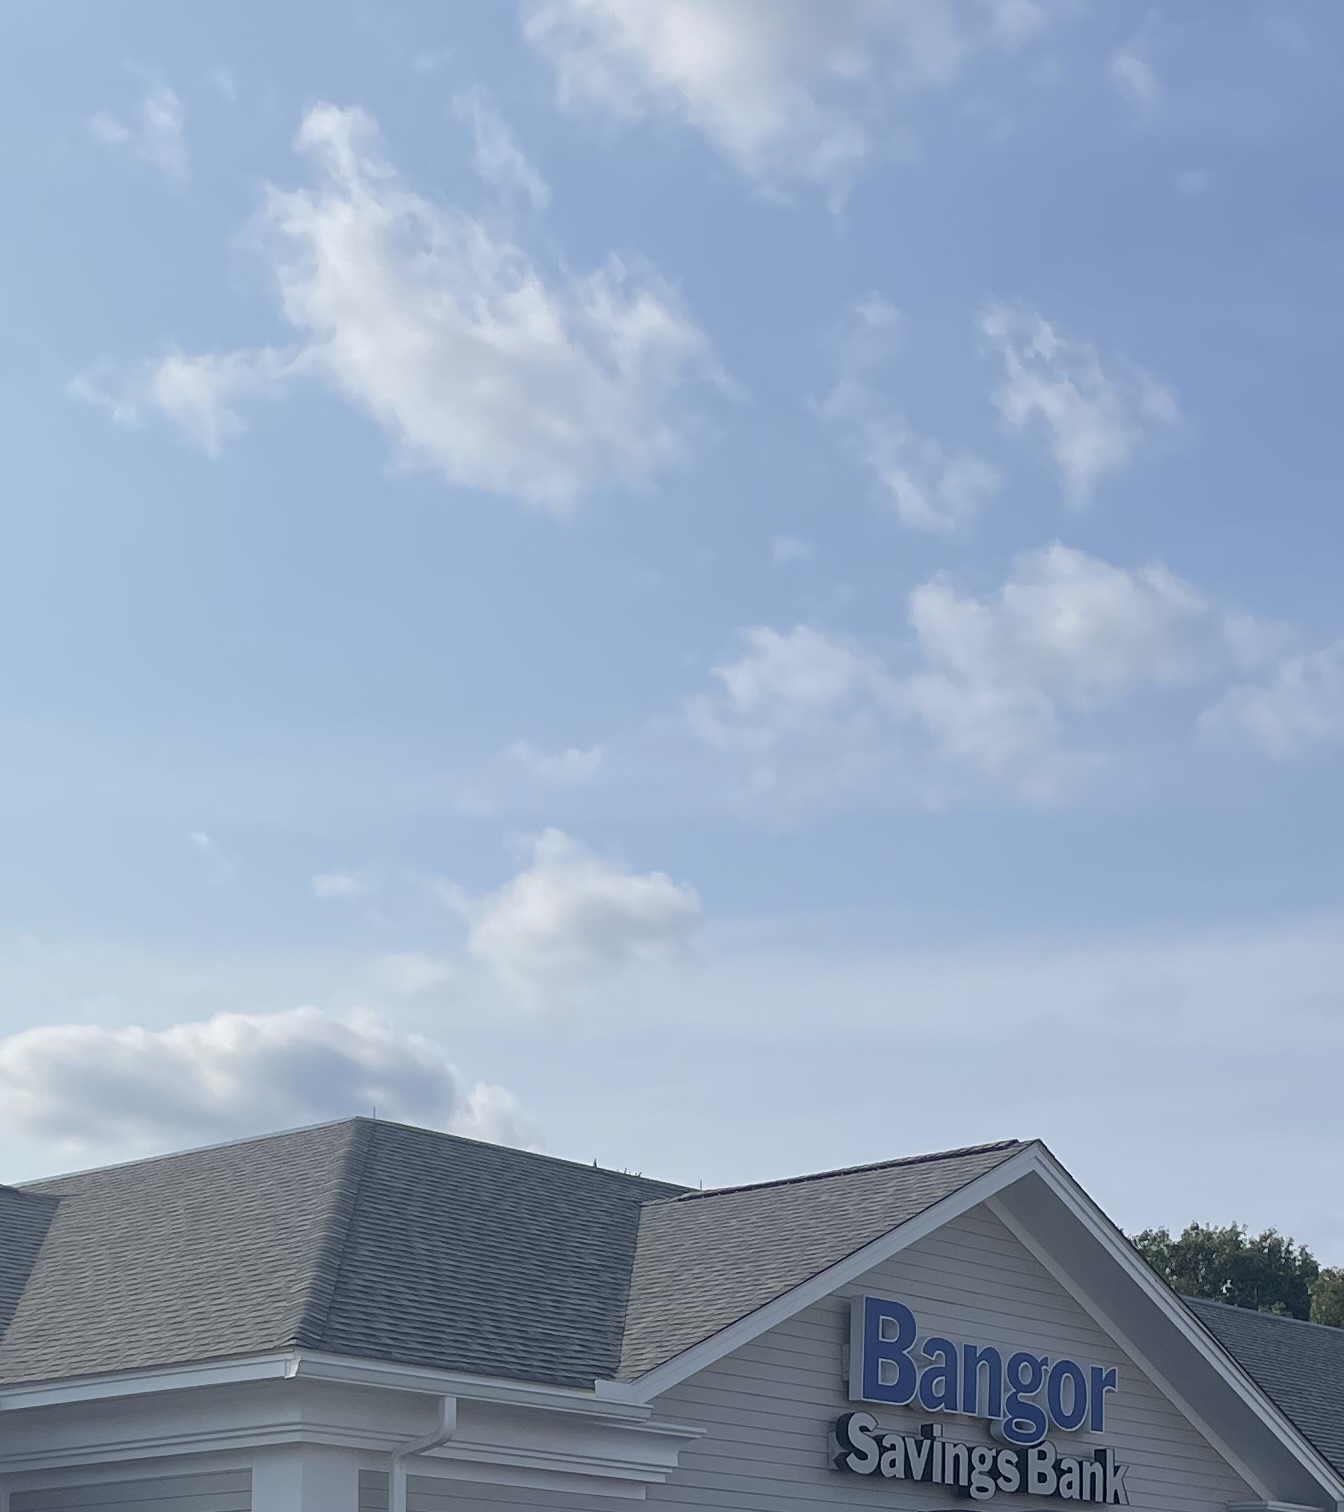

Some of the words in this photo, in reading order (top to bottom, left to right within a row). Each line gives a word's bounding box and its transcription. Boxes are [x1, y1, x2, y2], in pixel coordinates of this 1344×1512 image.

[862, 1295, 1118, 1445] Bangor
[845, 1411, 1021, 1500] Savings
[1027, 1440, 1130, 1505] Bank
